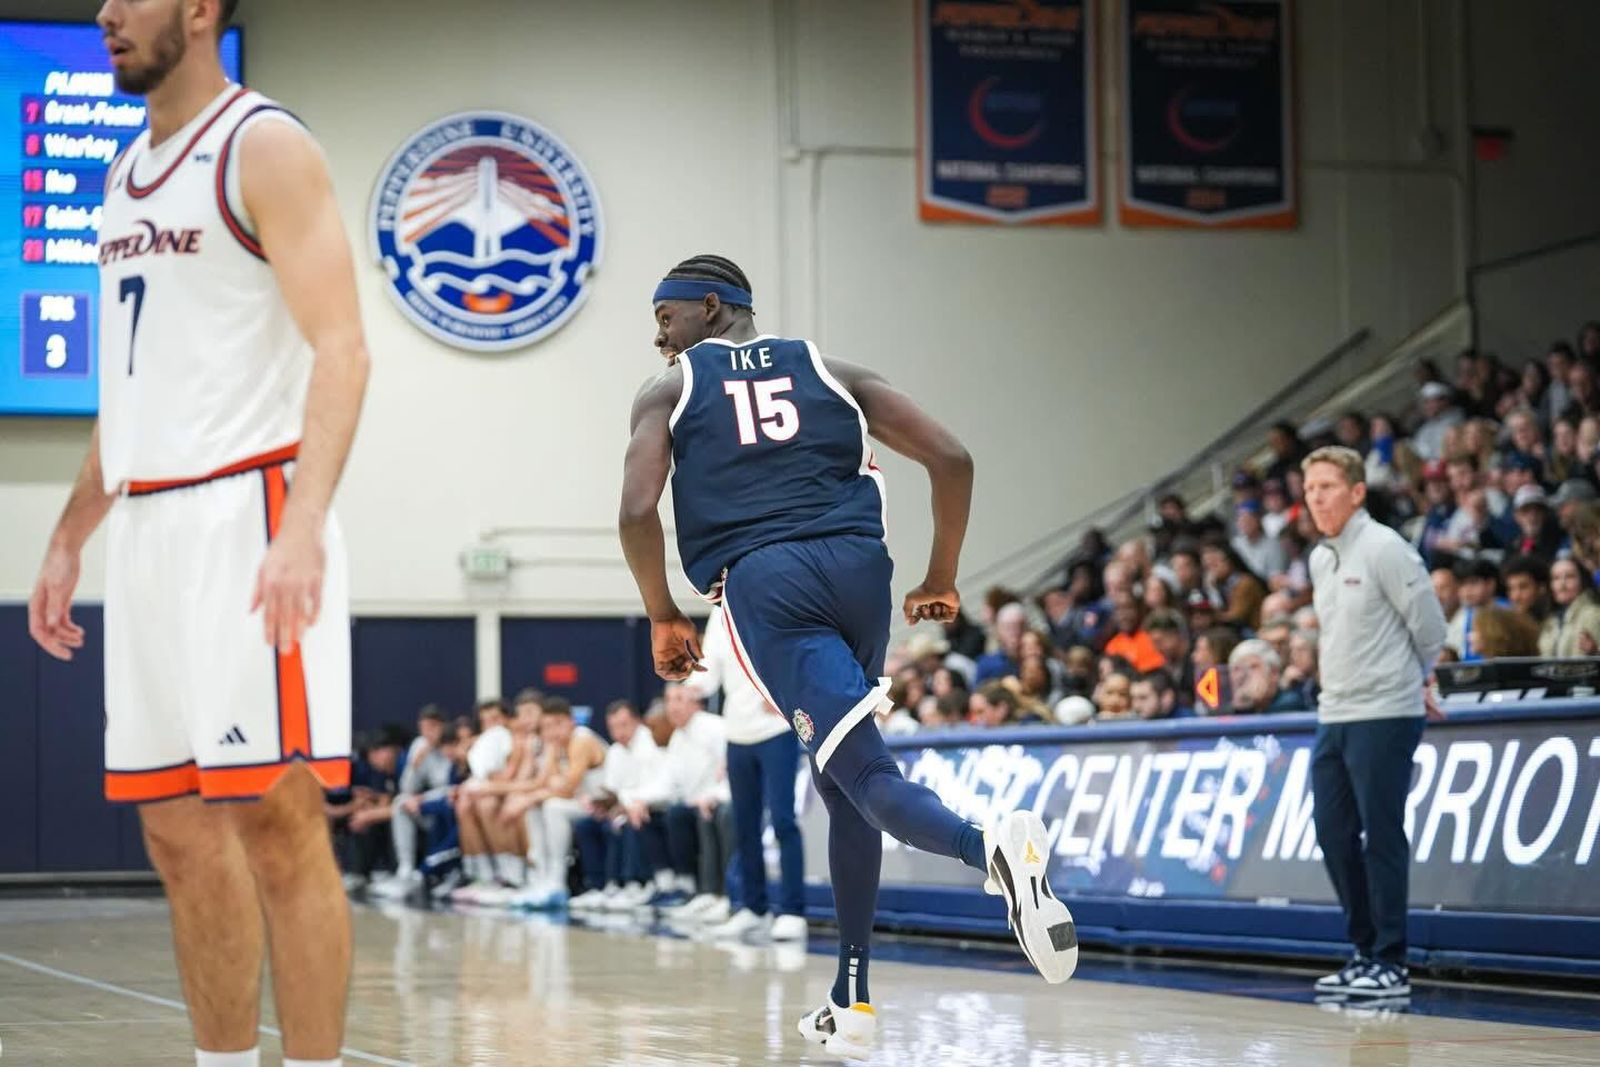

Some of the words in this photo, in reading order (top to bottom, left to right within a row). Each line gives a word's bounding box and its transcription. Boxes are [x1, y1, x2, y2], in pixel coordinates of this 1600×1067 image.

[119, 275, 146, 377] 7
[730, 346, 773, 371] IKE
[722, 376, 800, 446] 15
[1030, 748, 1257, 861] CENTER
